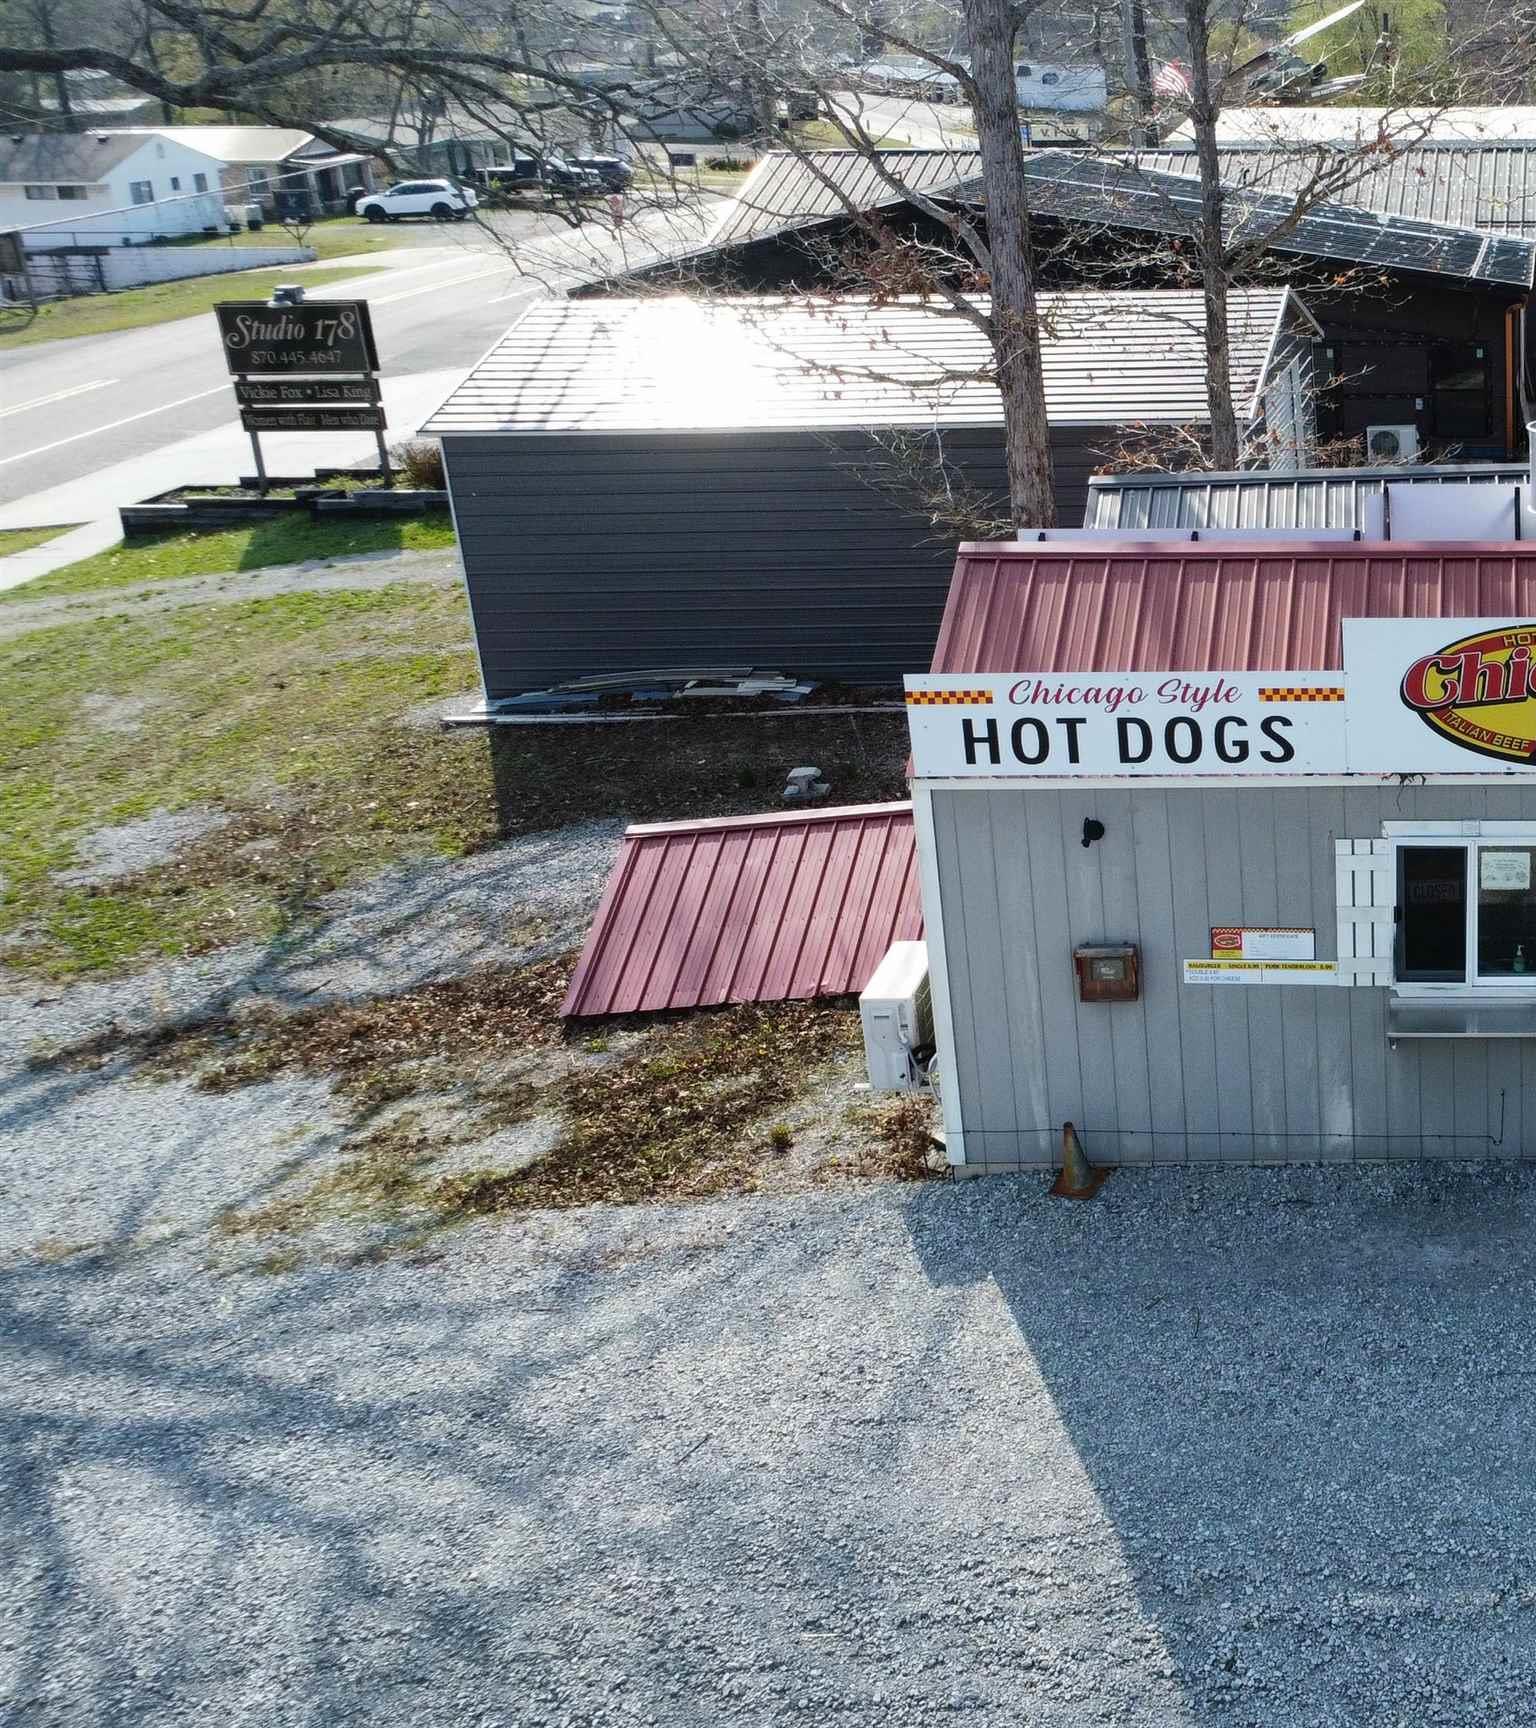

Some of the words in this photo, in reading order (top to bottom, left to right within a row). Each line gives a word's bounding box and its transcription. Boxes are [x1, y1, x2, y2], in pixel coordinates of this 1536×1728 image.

[226, 315, 305, 348] Studio
[315, 312, 355, 346] 178
[240, 385, 277, 398] Vickie
[280, 386, 303, 398] Fox
[314, 386, 339, 398] Lisa
[342, 385, 372, 400] King
[1008, 679, 1148, 713] Chicago
[1156, 678, 1241, 712] Style
[962, 717, 1087, 765] HOT
[1116, 716, 1296, 764] DOGS
[1441, 711, 1493, 744] ITALIAN
[1492, 734, 1531, 751] BEEF
